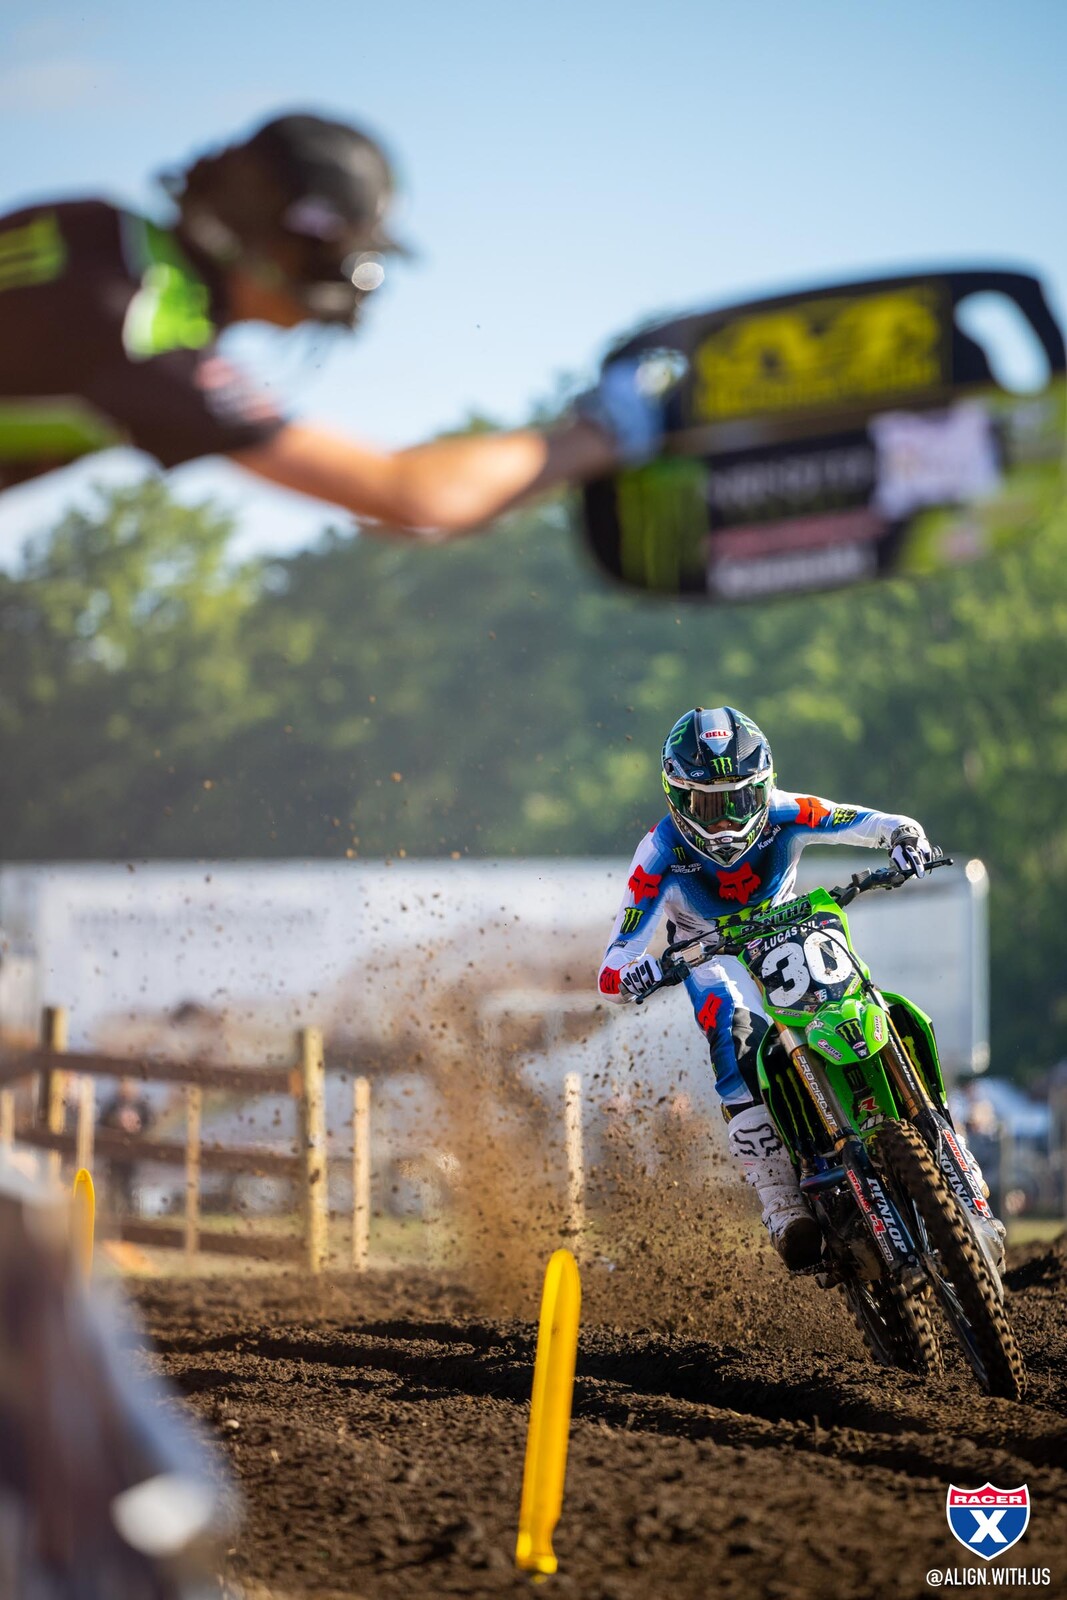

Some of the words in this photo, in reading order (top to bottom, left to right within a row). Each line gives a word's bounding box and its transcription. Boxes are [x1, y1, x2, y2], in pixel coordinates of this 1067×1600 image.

[761, 929, 853, 1007] 30
[764, 926, 797, 951] LUCAS
[942, 1129, 969, 1172] BRAKING
[866, 1177, 908, 1253] DUNLOP
